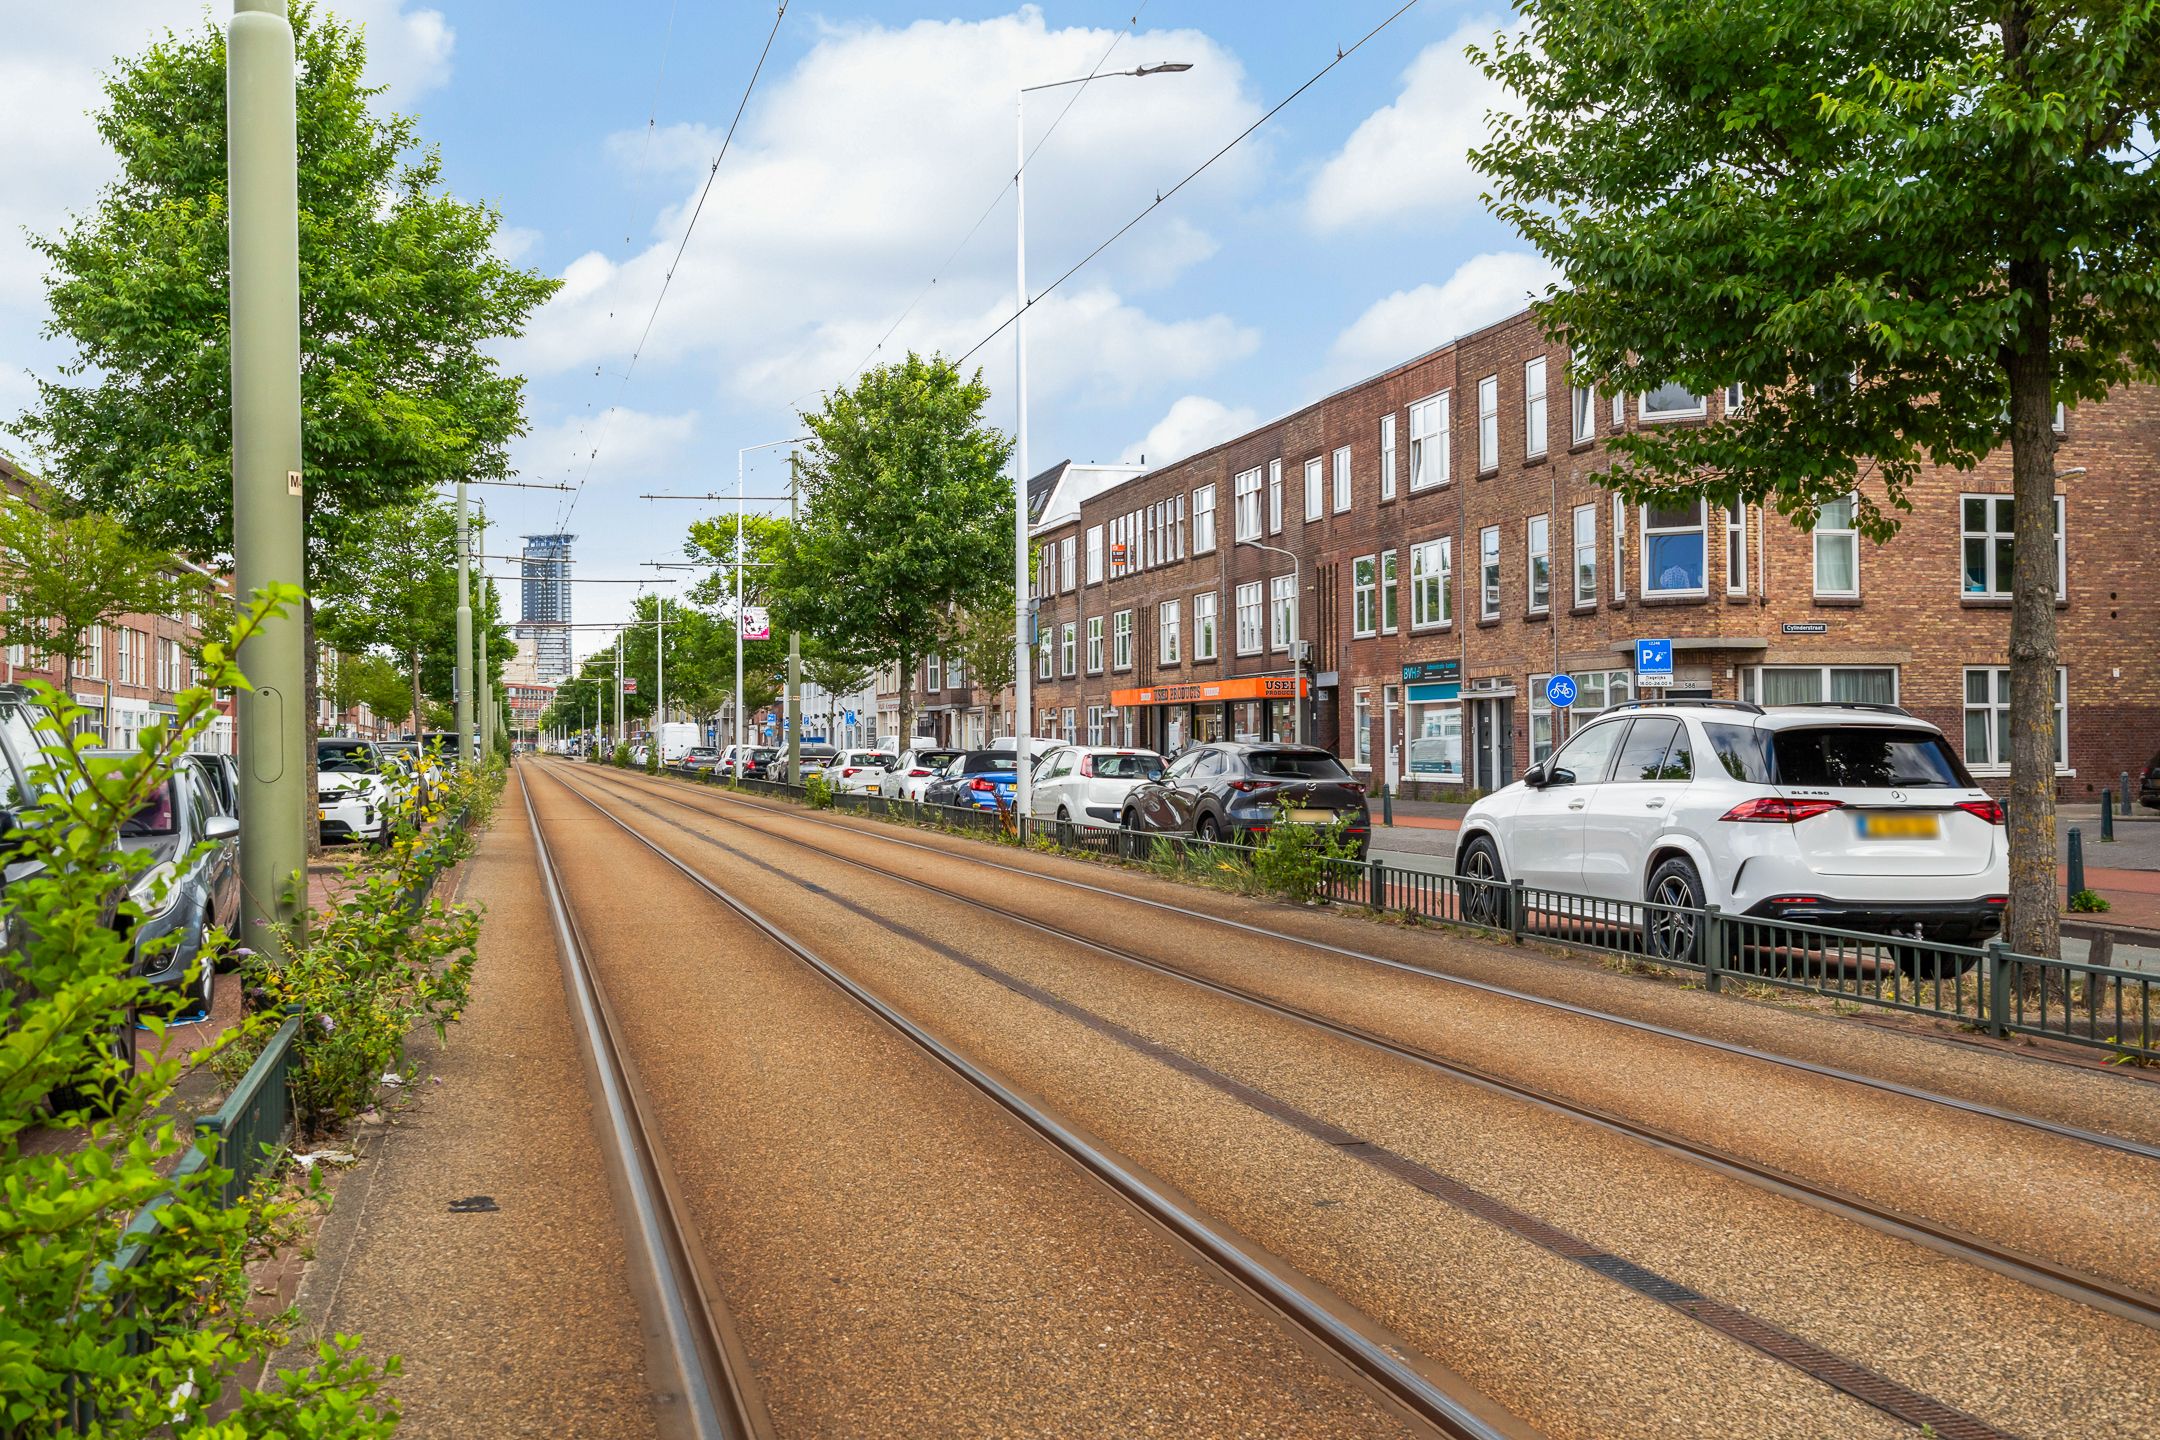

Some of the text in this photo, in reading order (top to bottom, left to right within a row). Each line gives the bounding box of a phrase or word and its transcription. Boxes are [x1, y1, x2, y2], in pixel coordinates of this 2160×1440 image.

[1643, 650, 1653, 664] P
[1404, 667, 1416, 679] BVH
[1265, 681, 1296, 690] USED
[1153, 688, 1168, 701] USED
[1169, 685, 1201, 700] PRODUCTS
